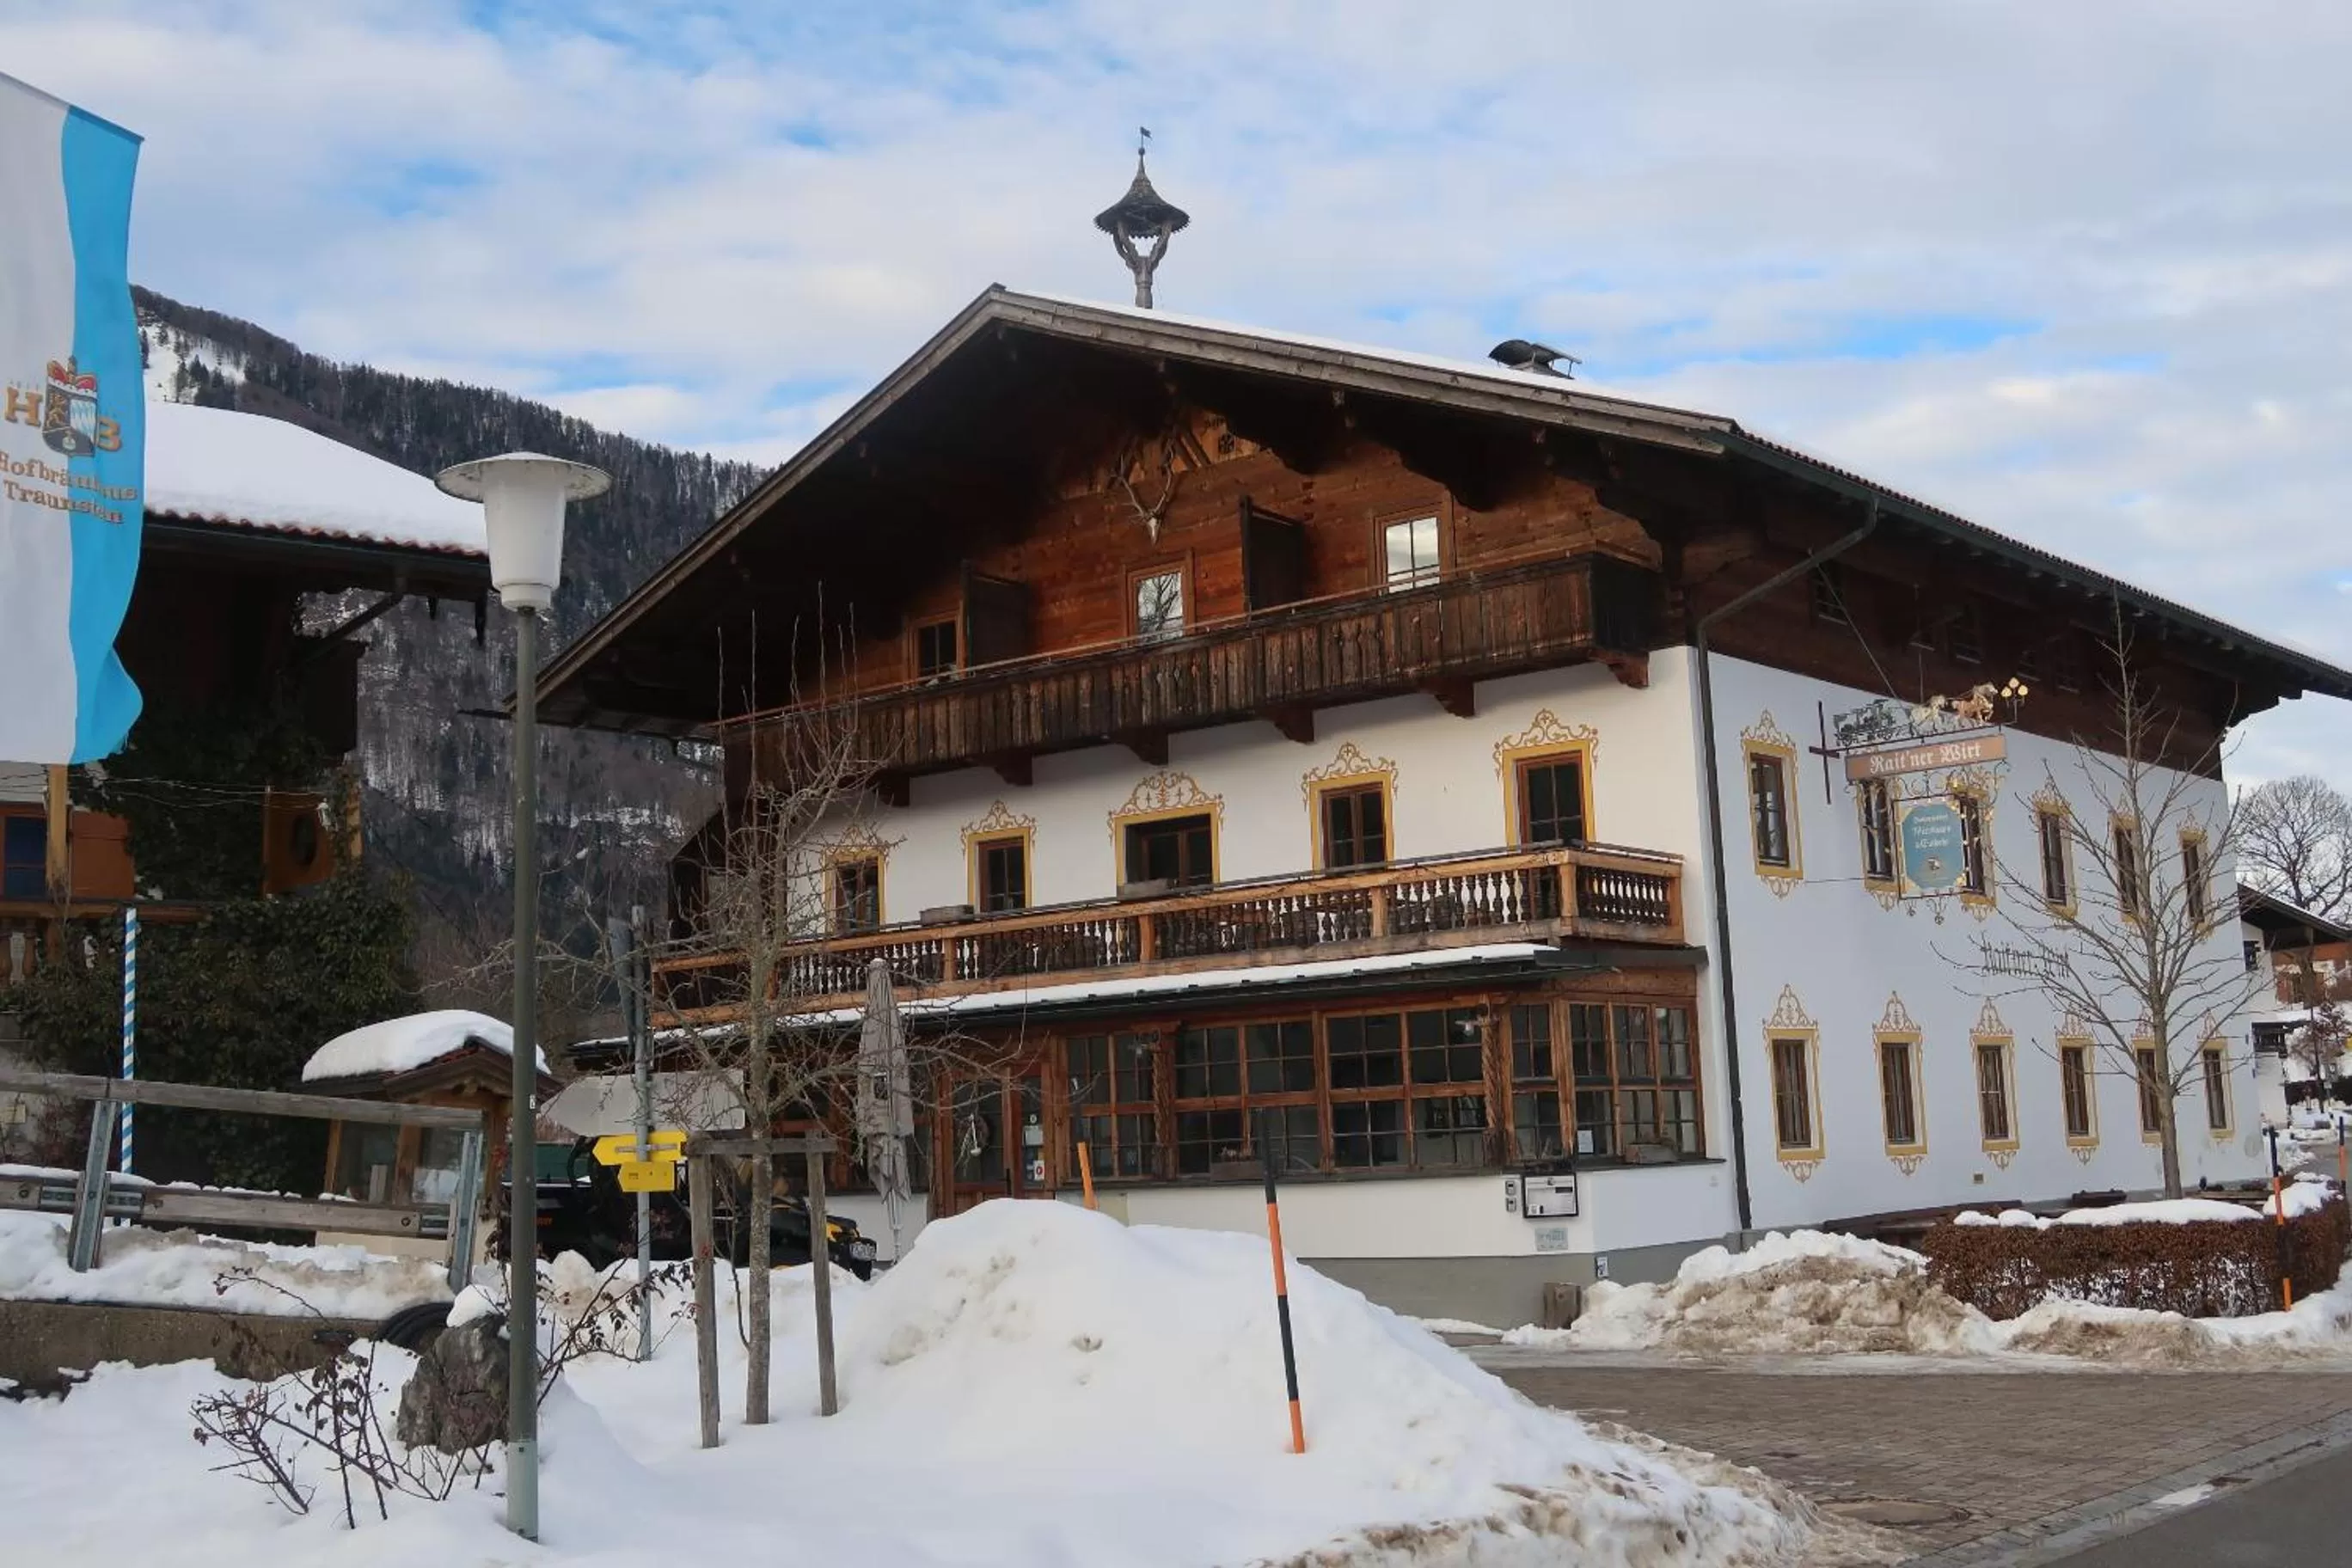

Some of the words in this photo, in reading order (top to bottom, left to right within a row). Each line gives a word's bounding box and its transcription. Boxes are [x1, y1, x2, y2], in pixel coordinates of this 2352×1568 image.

[5, 387, 43, 427] H
[95, 416, 122, 451] B
[1939, 742, 1981, 763] Wirt
